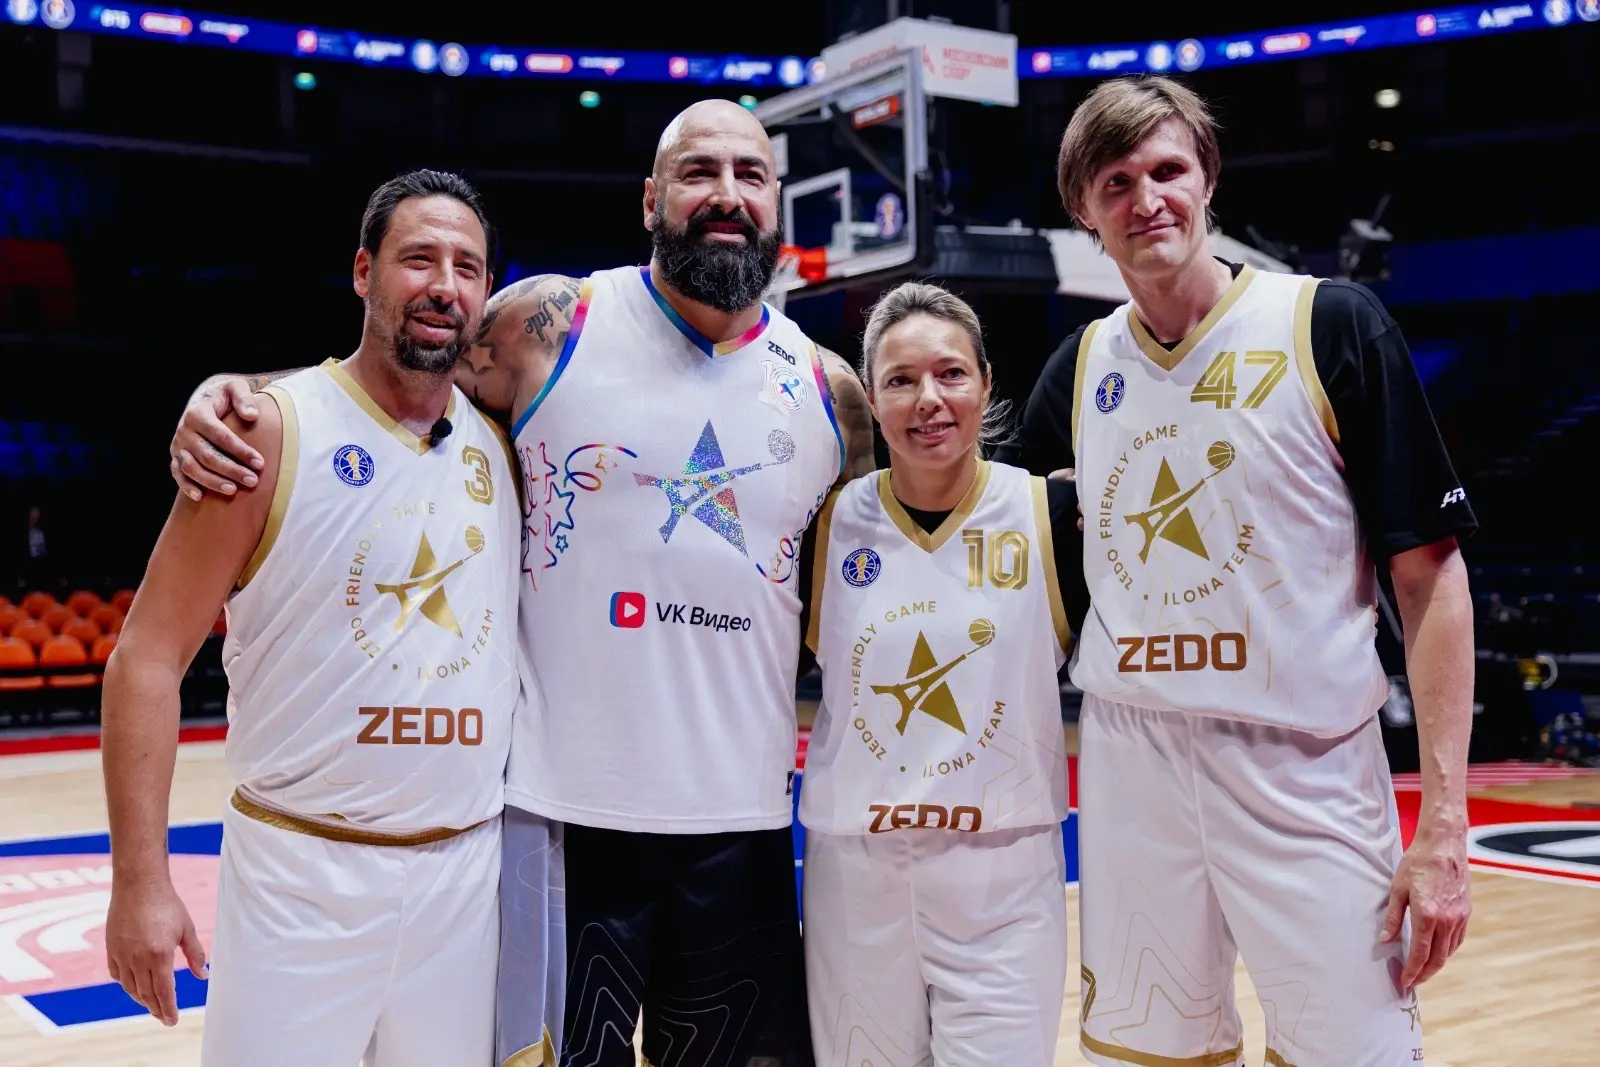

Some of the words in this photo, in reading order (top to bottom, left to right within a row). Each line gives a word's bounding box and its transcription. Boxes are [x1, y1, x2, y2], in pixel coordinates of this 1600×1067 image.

[768, 340, 796, 366] ZEDO
[1190, 350, 1288, 410] 47
[1133, 424, 1178, 450] GAME
[461, 445, 495, 506] 3
[1100, 452, 1130, 539] FRIENDLY
[962, 529, 1030, 591] 10
[1107, 548, 1133, 590] ZEDO
[1164, 577, 1223, 605] ILONA
[1222, 523, 1255, 575] TEAM
[351, 617, 381, 658] ZEDO
[471, 608, 494, 655] TEAM
[656, 602, 687, 624] VK
[689, 606, 751, 632] Видео
[1117, 632, 1247, 673] ZEDO
[854, 717, 887, 760] ZEDO
[884, 600, 936, 622] GAME
[356, 706, 483, 746] ZEDO
[922, 751, 976, 778] ILONA
[977, 700, 1006, 749] TEAM
[868, 804, 982, 833] ZEDO
